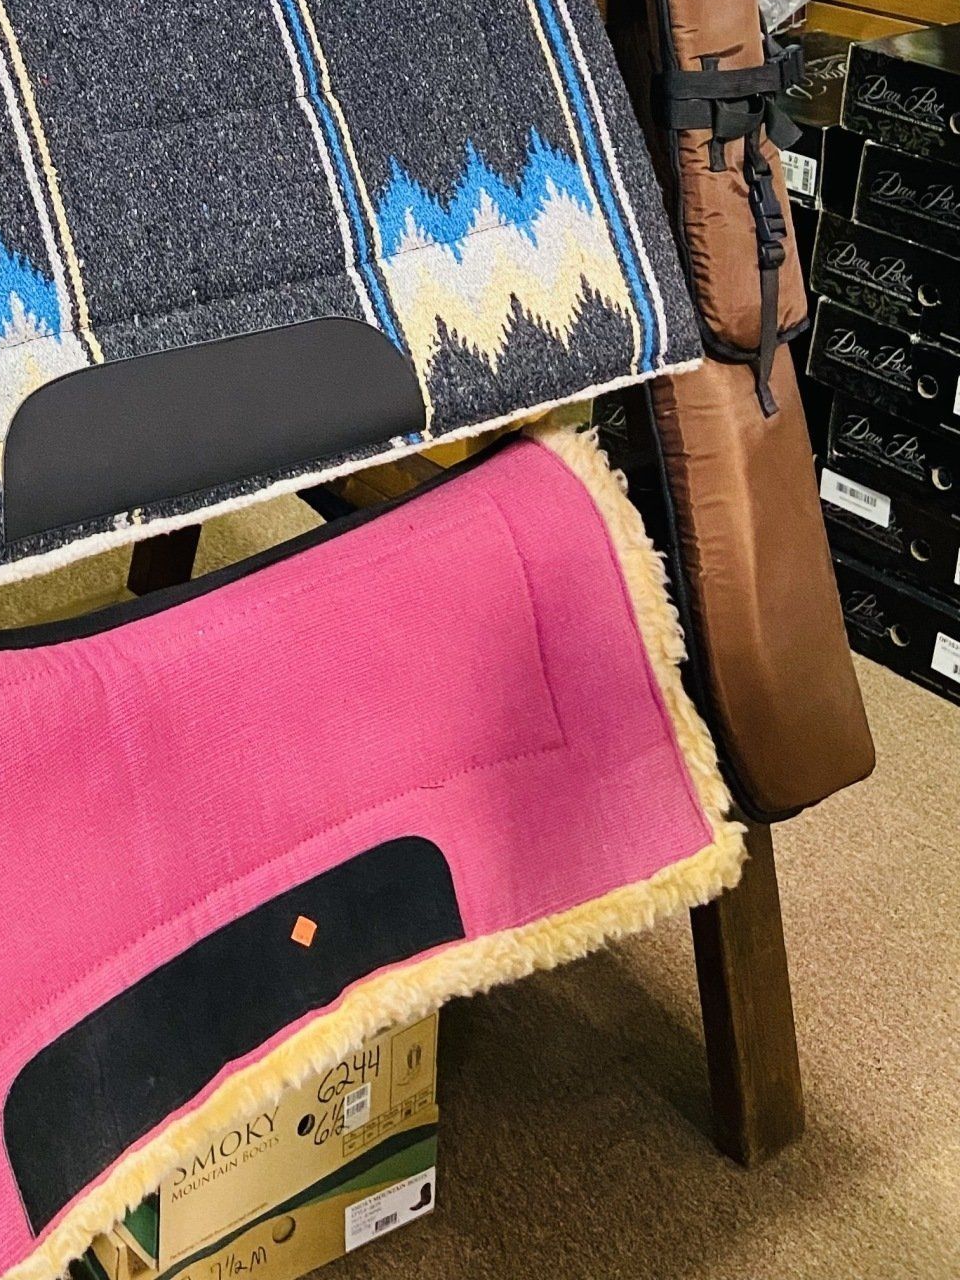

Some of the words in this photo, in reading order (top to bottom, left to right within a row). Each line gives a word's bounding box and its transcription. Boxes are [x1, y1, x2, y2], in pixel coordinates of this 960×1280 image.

[857, 74, 902, 105] Dan
[904, 86, 945, 116] Post
[871, 170, 917, 201] Dan
[826, 241, 871, 269] Dan
[872, 256, 913, 285] Post
[826, 328, 870, 356] Dan
[872, 345, 913, 375] Post
[840, 414, 883, 442] Dan
[885, 433, 926, 464] Post
[317, 1044, 380, 1103] 6244
[171, 1158, 238, 1203] MOUNTAIN
[242, 1134, 279, 1163] BOOTS
